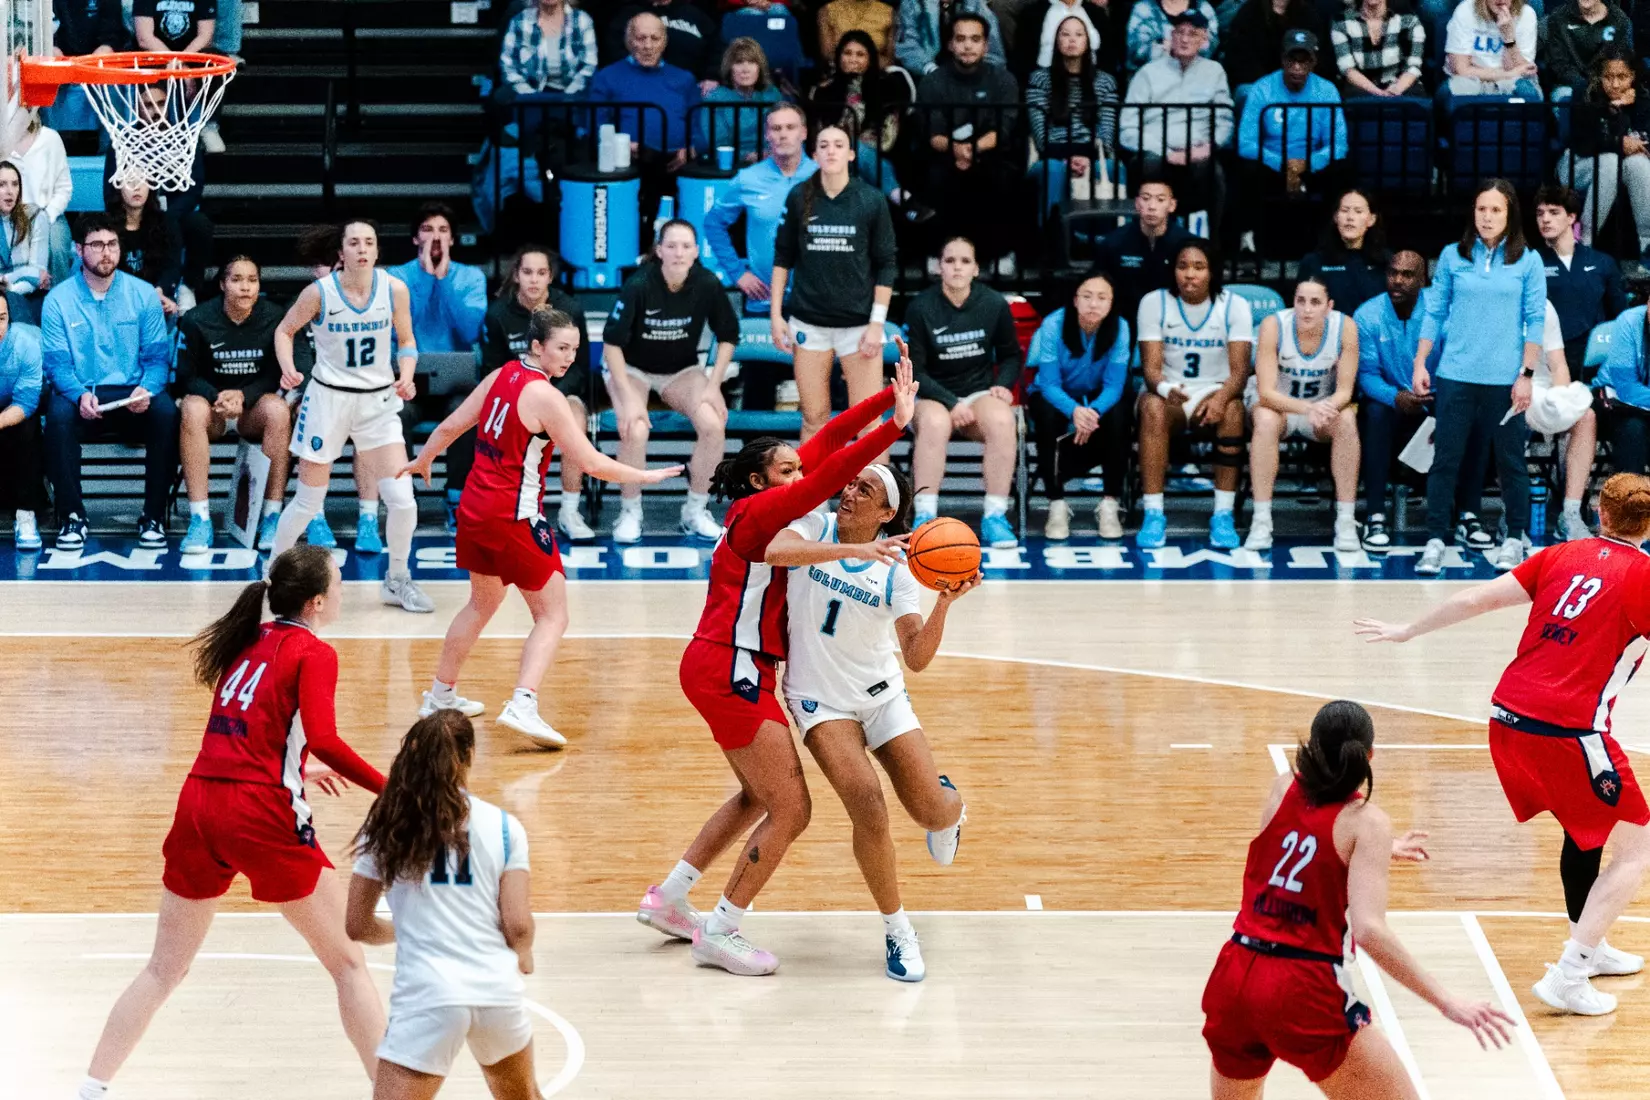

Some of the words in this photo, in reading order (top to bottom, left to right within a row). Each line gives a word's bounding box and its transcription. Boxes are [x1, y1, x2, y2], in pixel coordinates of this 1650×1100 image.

[594, 188, 607, 260] POWERADE
[807, 225, 857, 234] COLUMBIA
[328, 317, 389, 332] COLUMBIA
[936, 329, 986, 344] COLUMBIA
[213, 349, 264, 359] COLUMBIA
[345, 337, 376, 368] 12
[1164, 336, 1224, 348] COLUMBIA
[1183, 352, 1201, 378] 3
[1289, 380, 1321, 398] 15
[484, 396, 511, 440] 14
[808, 564, 881, 608] COLUMBIA
[1551, 574, 1603, 620] 13
[820, 597, 843, 637] 1
[219, 658, 268, 712] 44
[1267, 830, 1318, 893] 22
